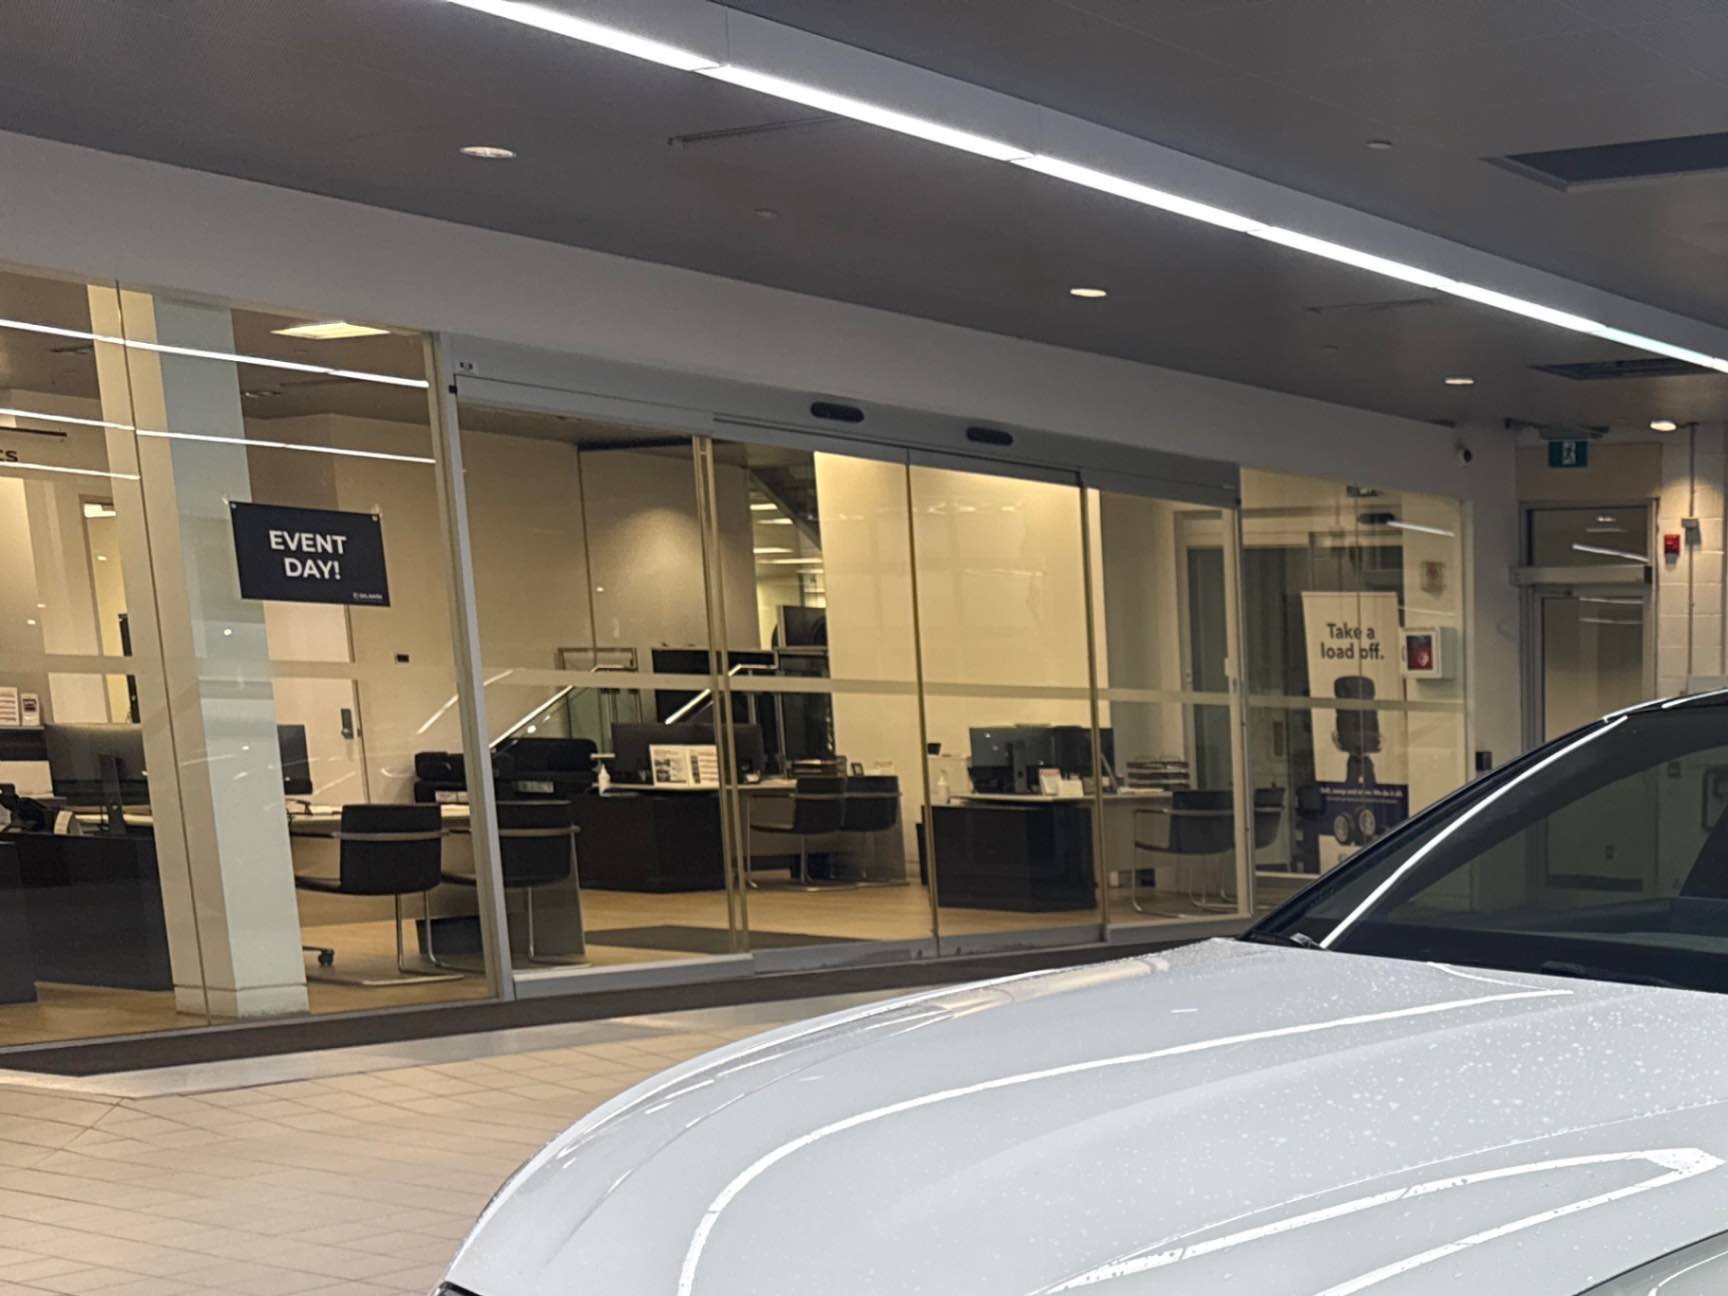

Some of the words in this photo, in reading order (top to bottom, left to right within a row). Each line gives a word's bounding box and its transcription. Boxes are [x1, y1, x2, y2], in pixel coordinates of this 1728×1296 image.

[268, 529, 347, 555] EVENT
[284, 557, 342, 580] DAY!
[1326, 622, 1362, 640] Take
[1366, 627, 1376, 640] a
[1320, 642, 1355, 660] load
[1359, 642, 1385, 660] off.
